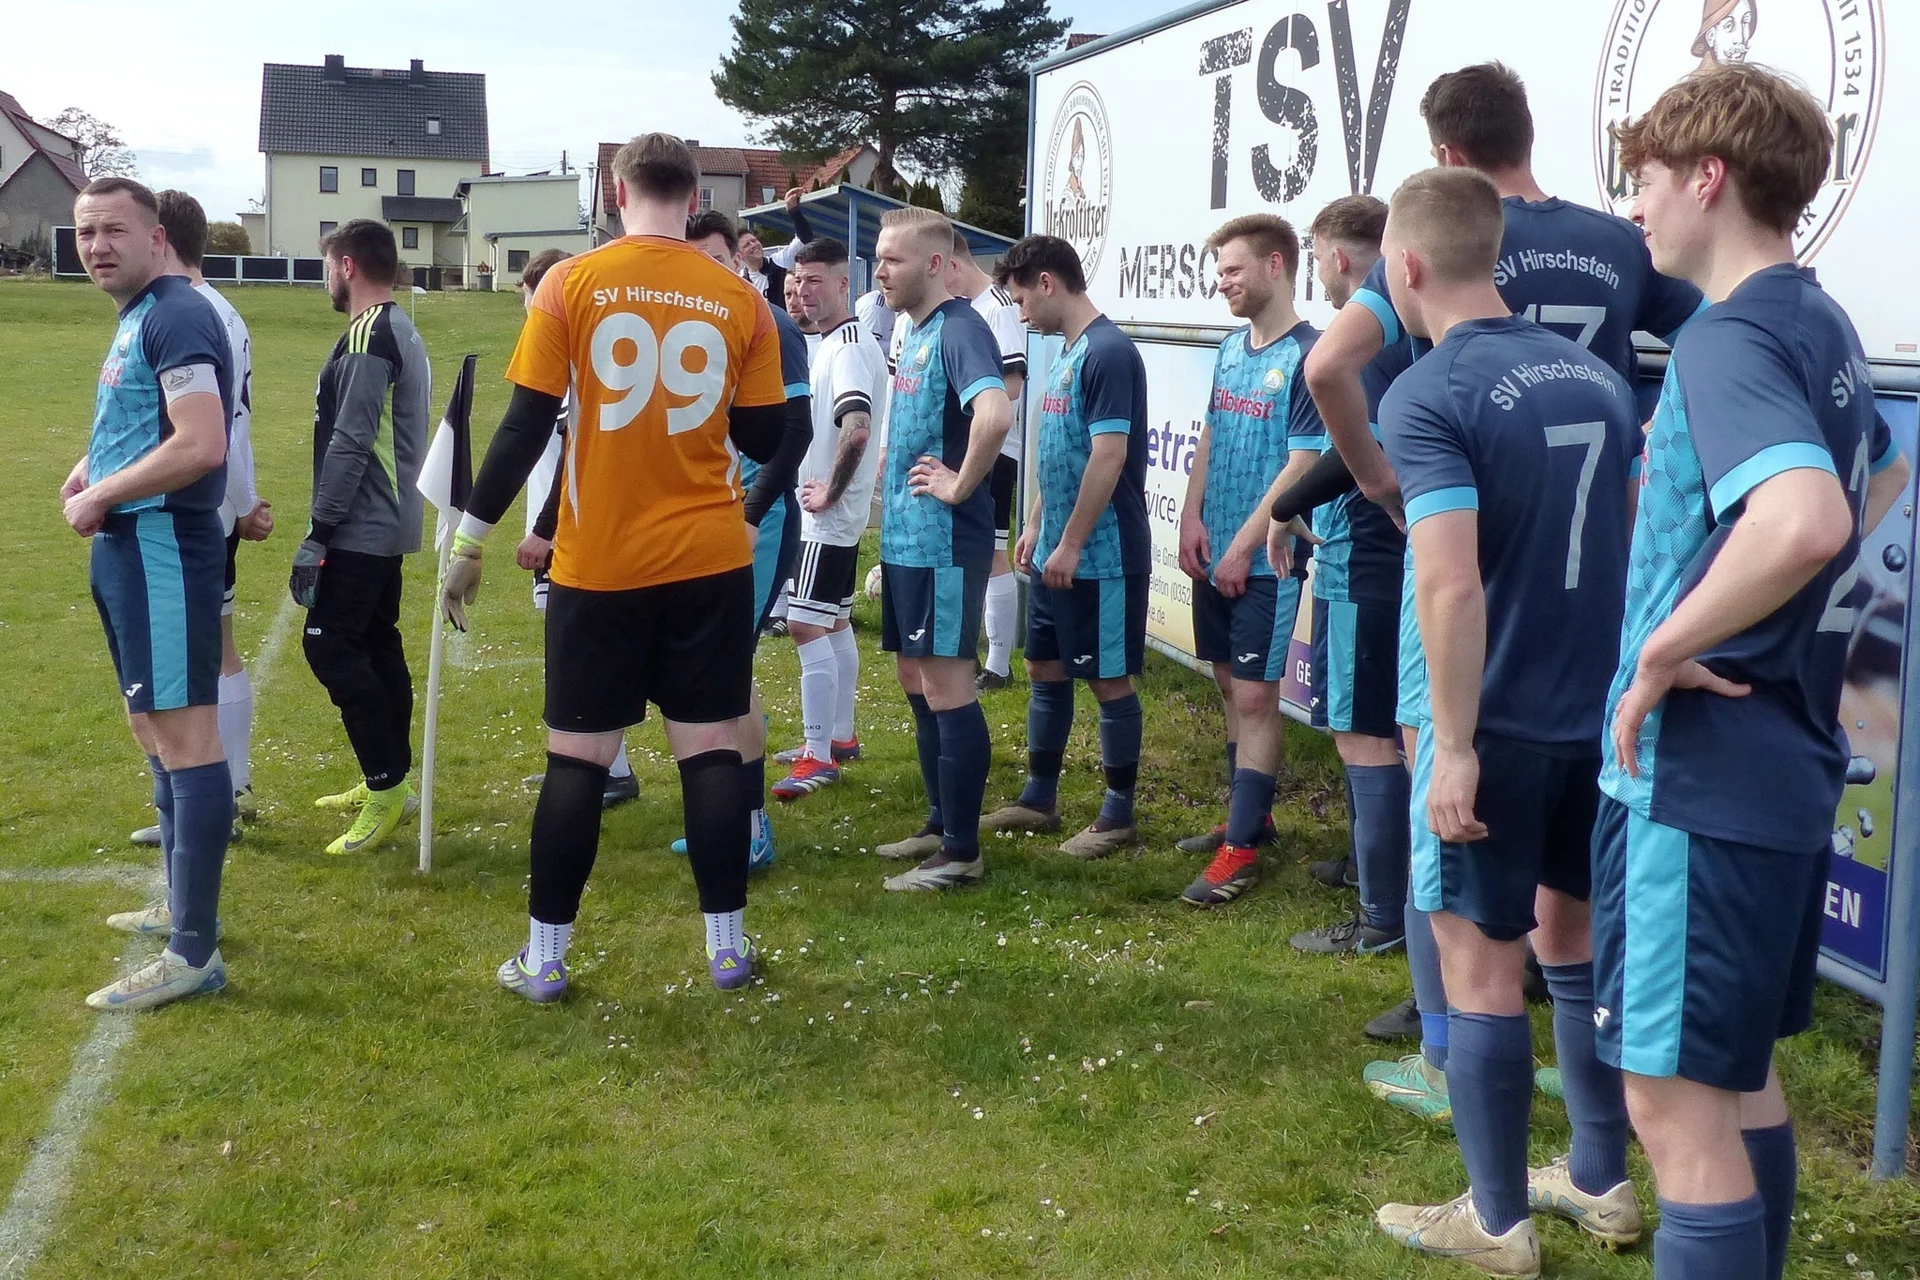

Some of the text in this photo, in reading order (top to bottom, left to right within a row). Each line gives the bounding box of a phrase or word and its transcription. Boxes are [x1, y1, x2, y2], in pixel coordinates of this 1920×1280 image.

[1843, 31, 1862, 97] 1534
[1199, 0, 1411, 210] TSV
[1494, 249, 1620, 290] SV Hirschstein
[593, 286, 730, 320] SV Hirschstein
[590, 312, 728, 436] 99
[1490, 358, 1617, 411] SV Hirschstein
[1144, 483, 1179, 531] vice,
[1544, 421, 1606, 590] 7
[1162, 547, 1179, 570] Gmb
[1823, 880, 1861, 928] EN
